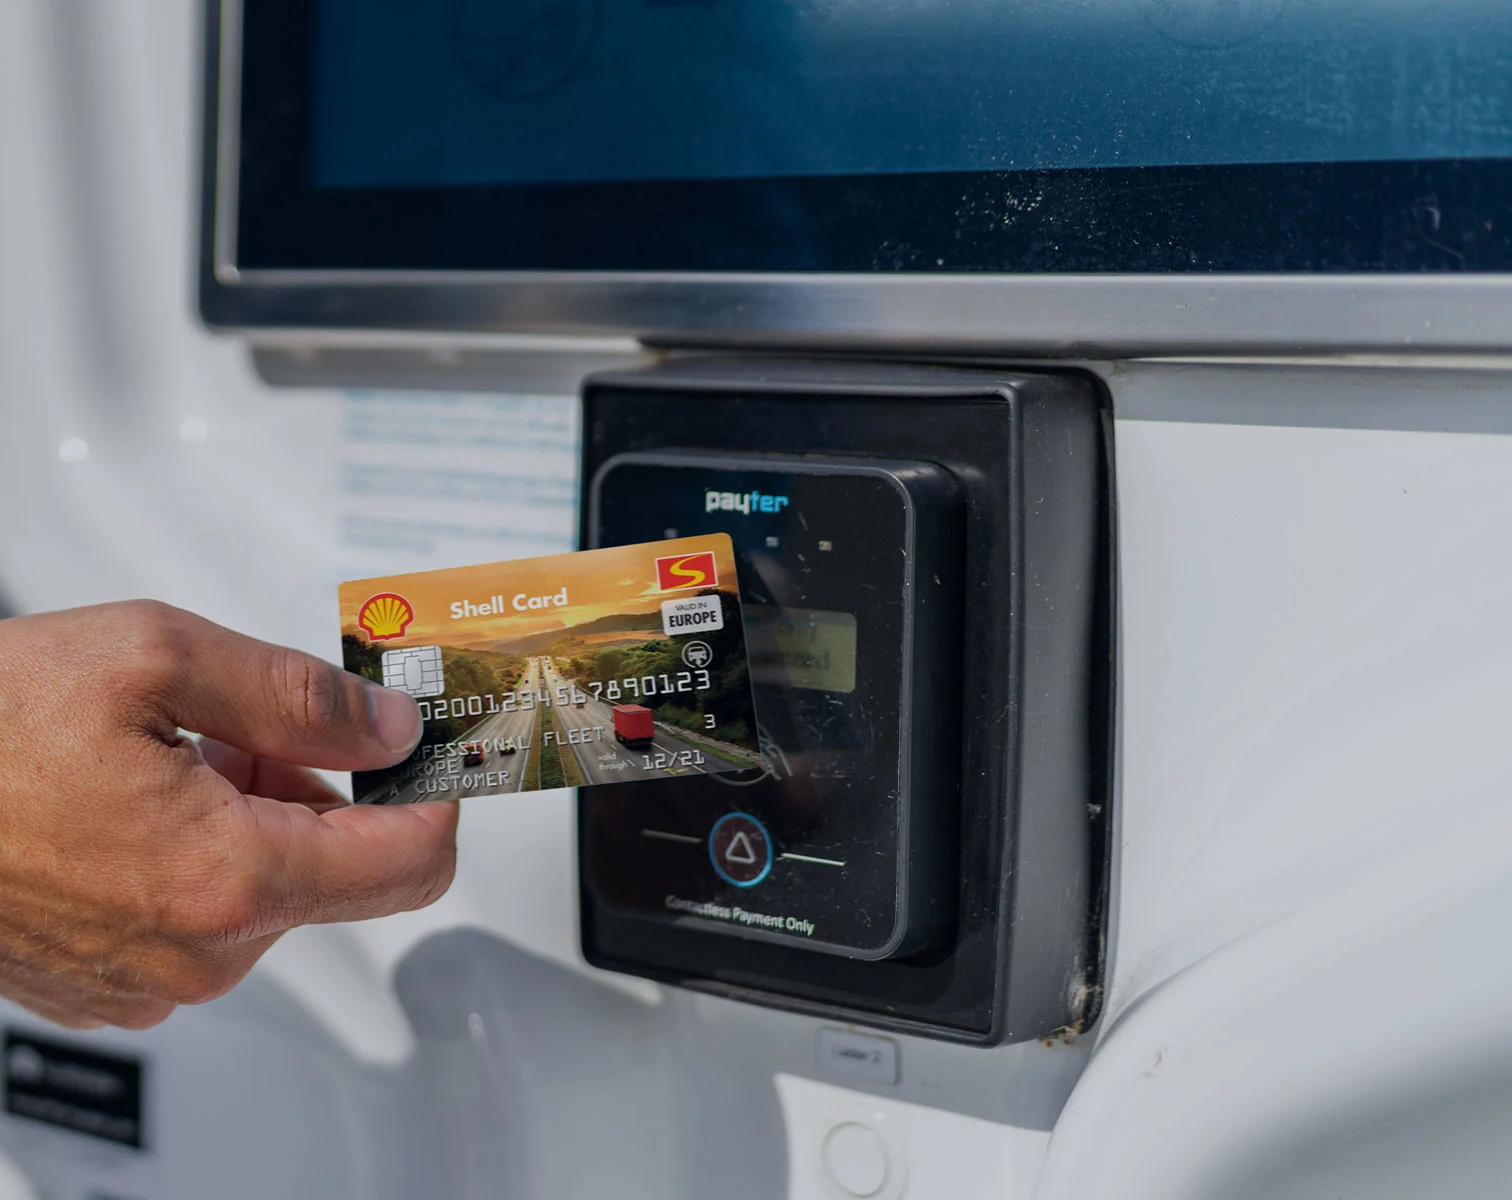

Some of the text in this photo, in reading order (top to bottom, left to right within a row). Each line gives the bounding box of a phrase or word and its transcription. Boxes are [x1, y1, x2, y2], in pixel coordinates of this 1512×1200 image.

[705, 490, 789, 516] payter
[450, 587, 568, 619] Shell Card
[674, 603, 697, 611] VALID
[669, 610, 717, 628] EUROPE
[418, 669, 711, 722] 02001234567890123
[703, 713, 716, 729] 3
[412, 726, 606, 761] OFESSIONAL FLEET
[598, 752, 617, 761] valid
[642, 749, 705, 770] 12/21
[391, 758, 459, 780] UROPE
[415, 770, 510, 794] CUSTOMER
[732, 907, 785, 929] Payment
[786, 917, 816, 937] Only
